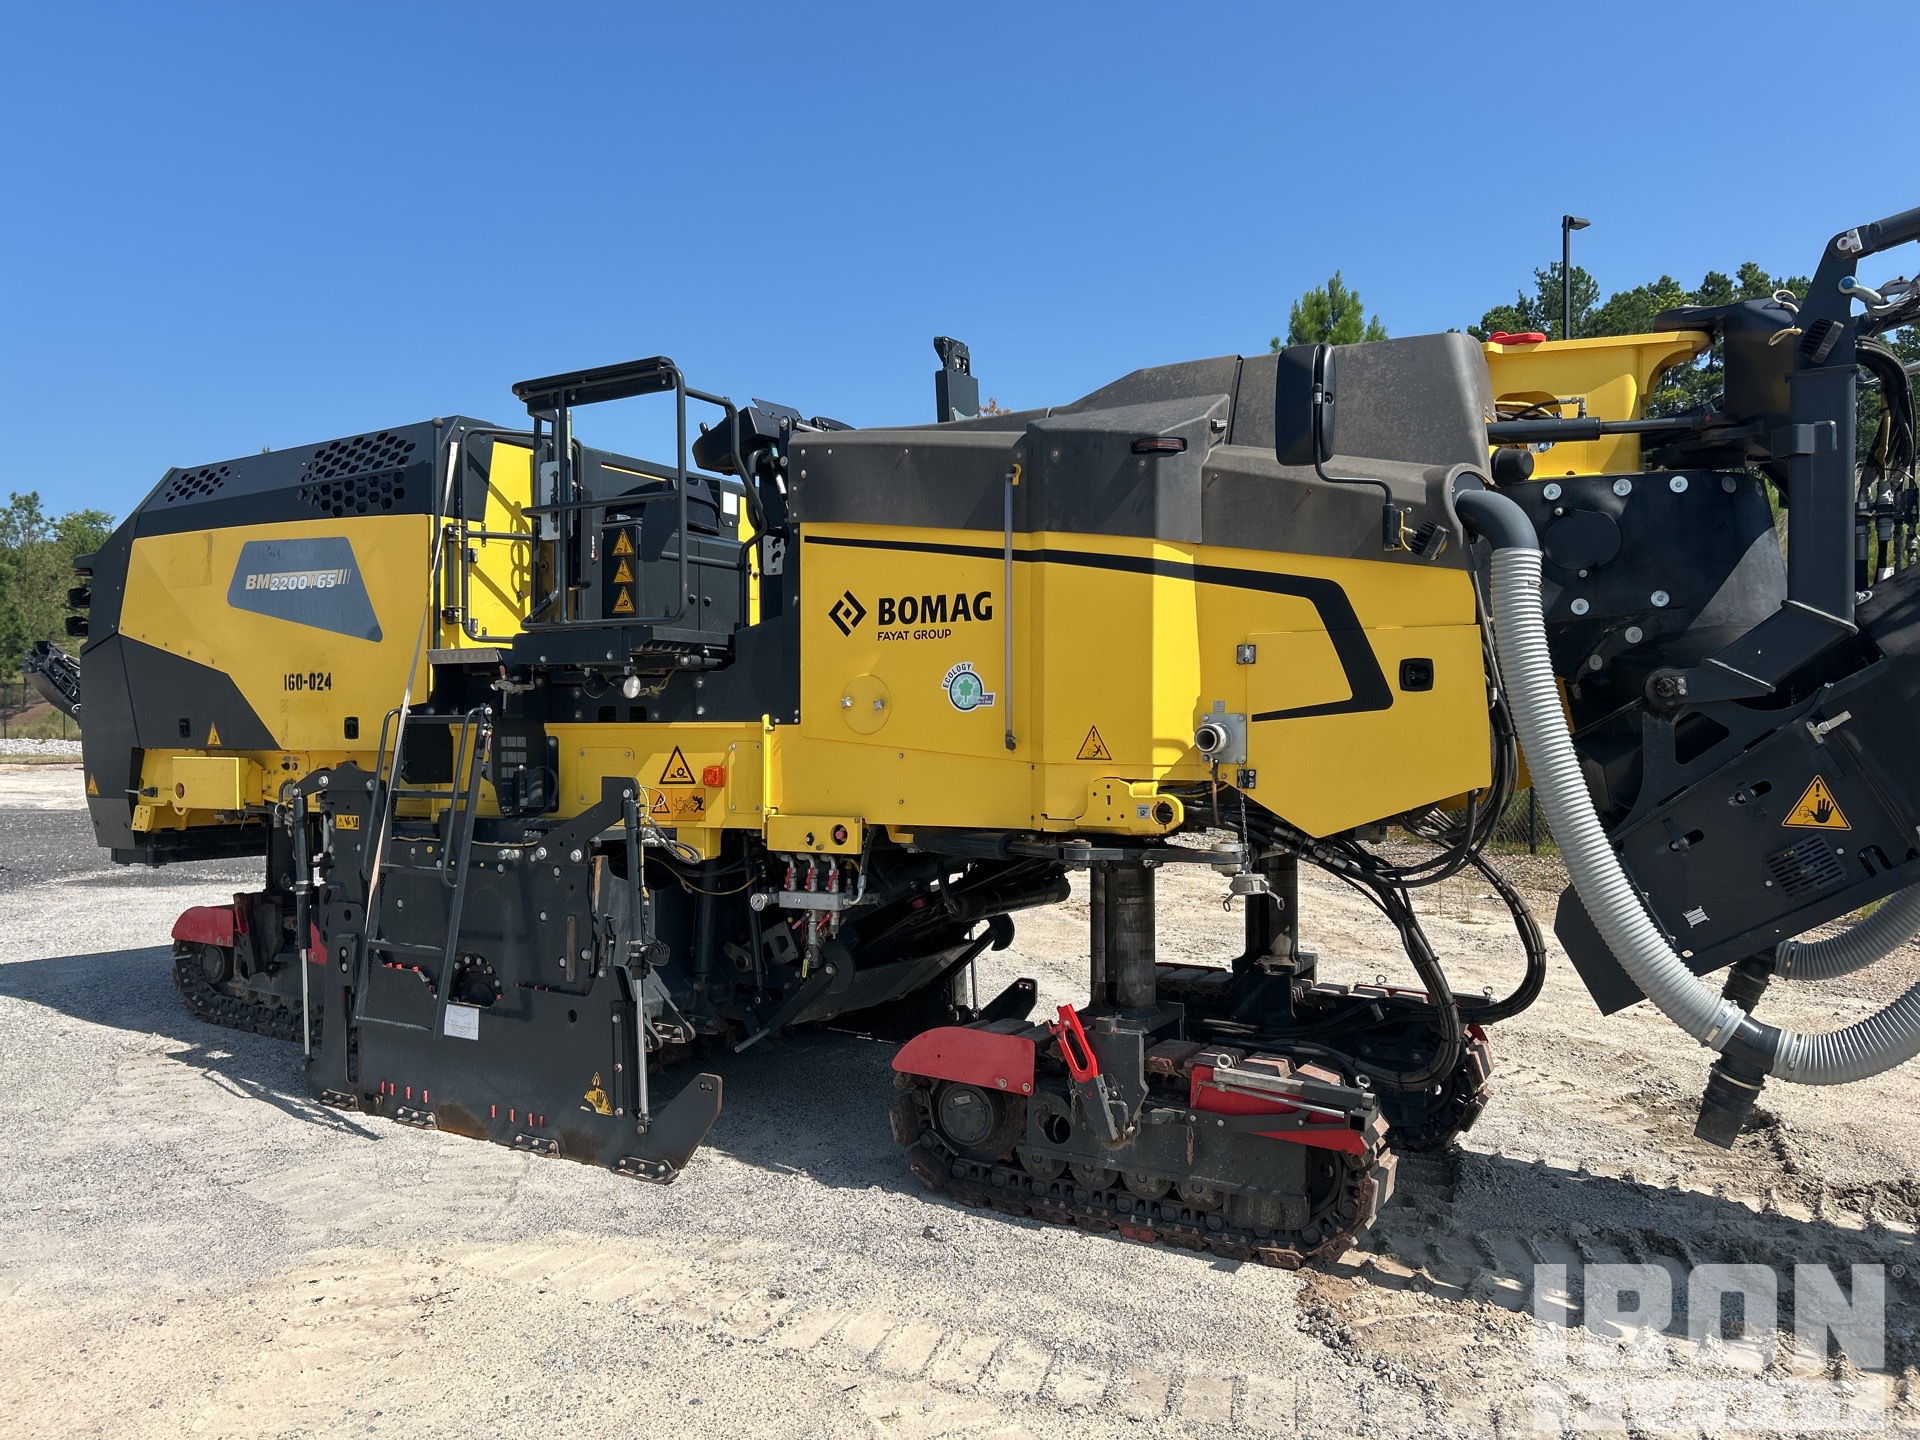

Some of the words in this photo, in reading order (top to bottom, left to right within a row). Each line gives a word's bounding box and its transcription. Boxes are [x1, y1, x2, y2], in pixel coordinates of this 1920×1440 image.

[878, 591, 993, 626] BOMAG
[877, 631, 910, 642] FAYAT
[913, 629, 952, 640] GROUP
[943, 663, 972, 688] ECOLOGY
